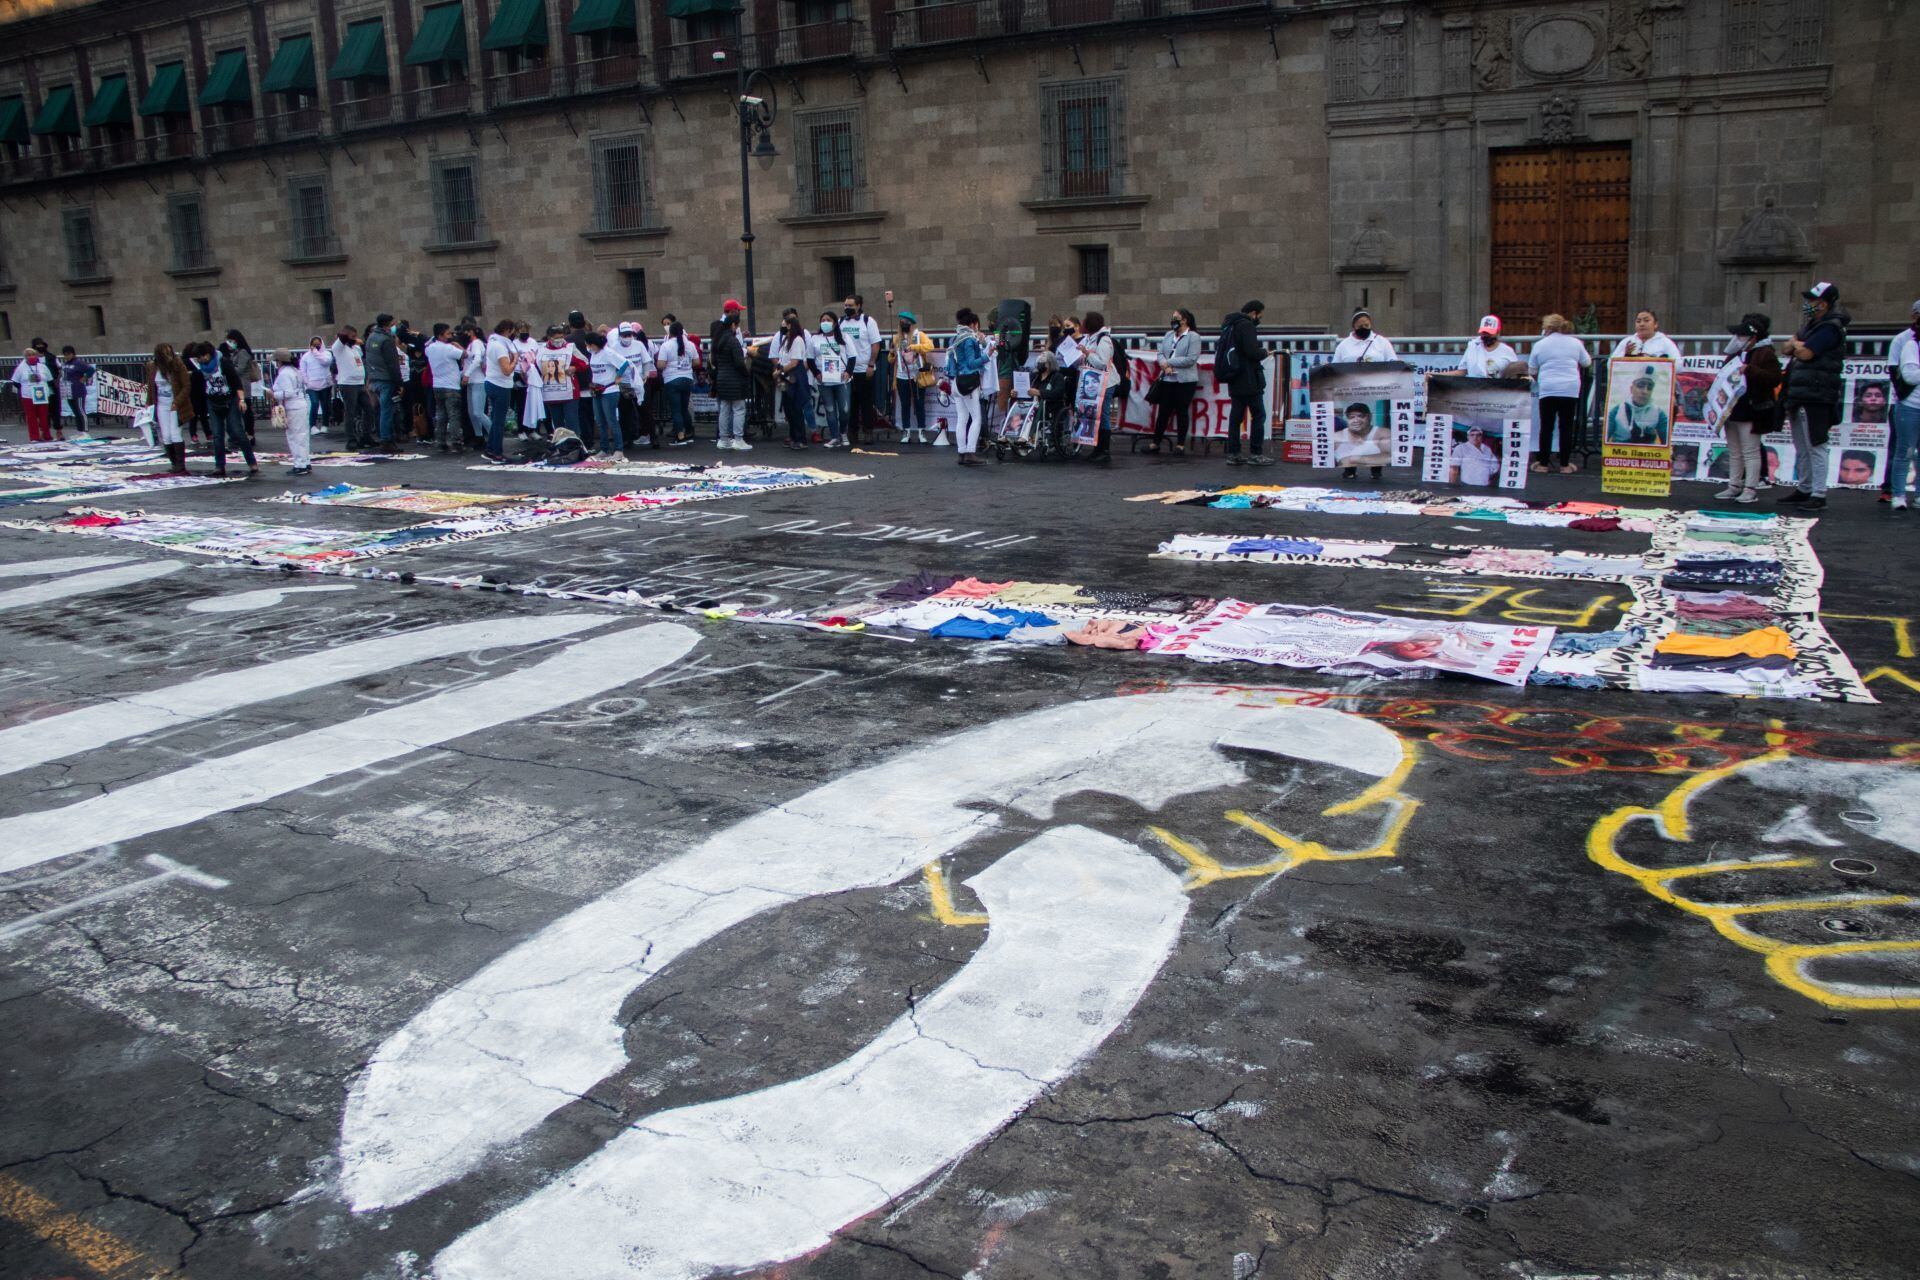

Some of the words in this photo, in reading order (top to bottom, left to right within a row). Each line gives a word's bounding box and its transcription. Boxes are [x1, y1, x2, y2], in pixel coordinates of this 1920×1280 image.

[1396, 401, 1411, 464] MARCOS
[1506, 421, 1521, 488] EDUARDO
[1611, 448, 1628, 456] Me
[1630, 449, 1662, 458] llamo
[1640, 460, 1669, 469] AGUILAR
